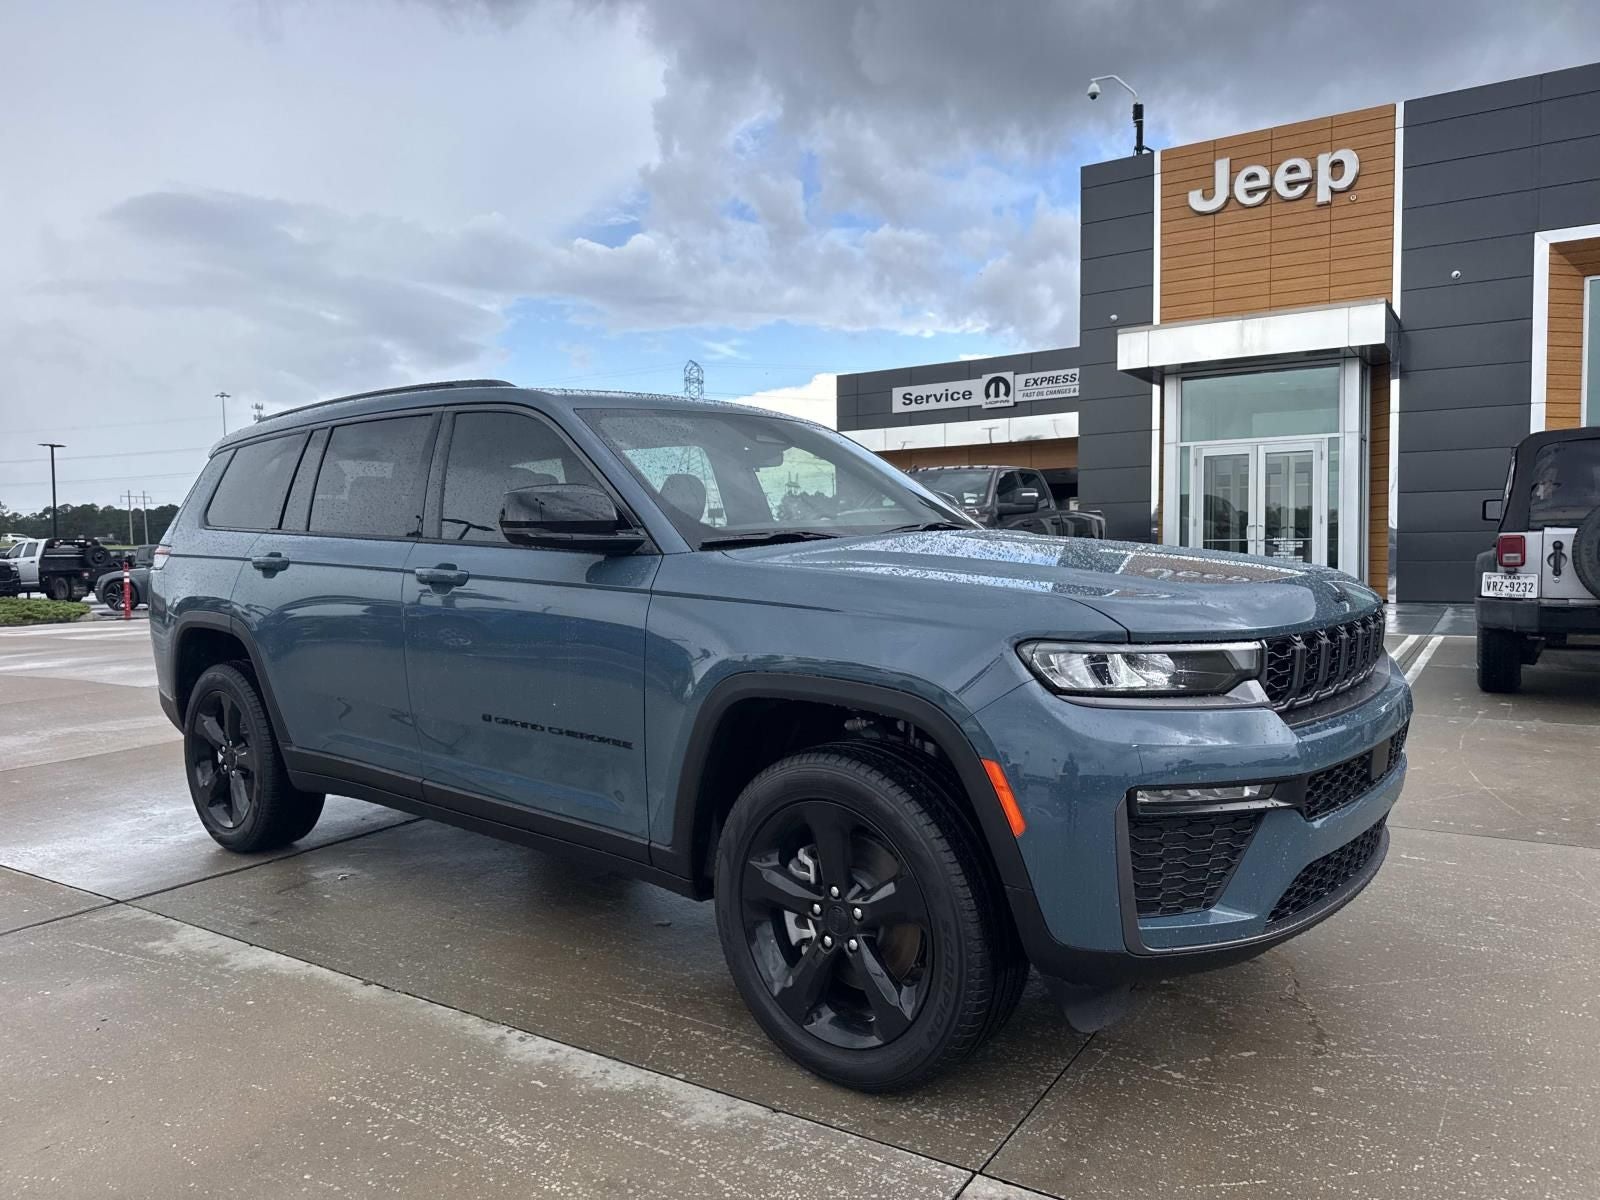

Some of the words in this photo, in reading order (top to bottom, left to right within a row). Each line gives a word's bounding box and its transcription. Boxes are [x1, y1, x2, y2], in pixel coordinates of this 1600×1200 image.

[1188, 149, 1359, 214] Jeep
[1024, 373, 1077, 388] EXPRESS
[902, 388, 973, 406] Service
[1045, 388, 1069, 396] CHANGES
[494, 717, 545, 732] GRAND
[548, 727, 633, 750] CHEROKEE
